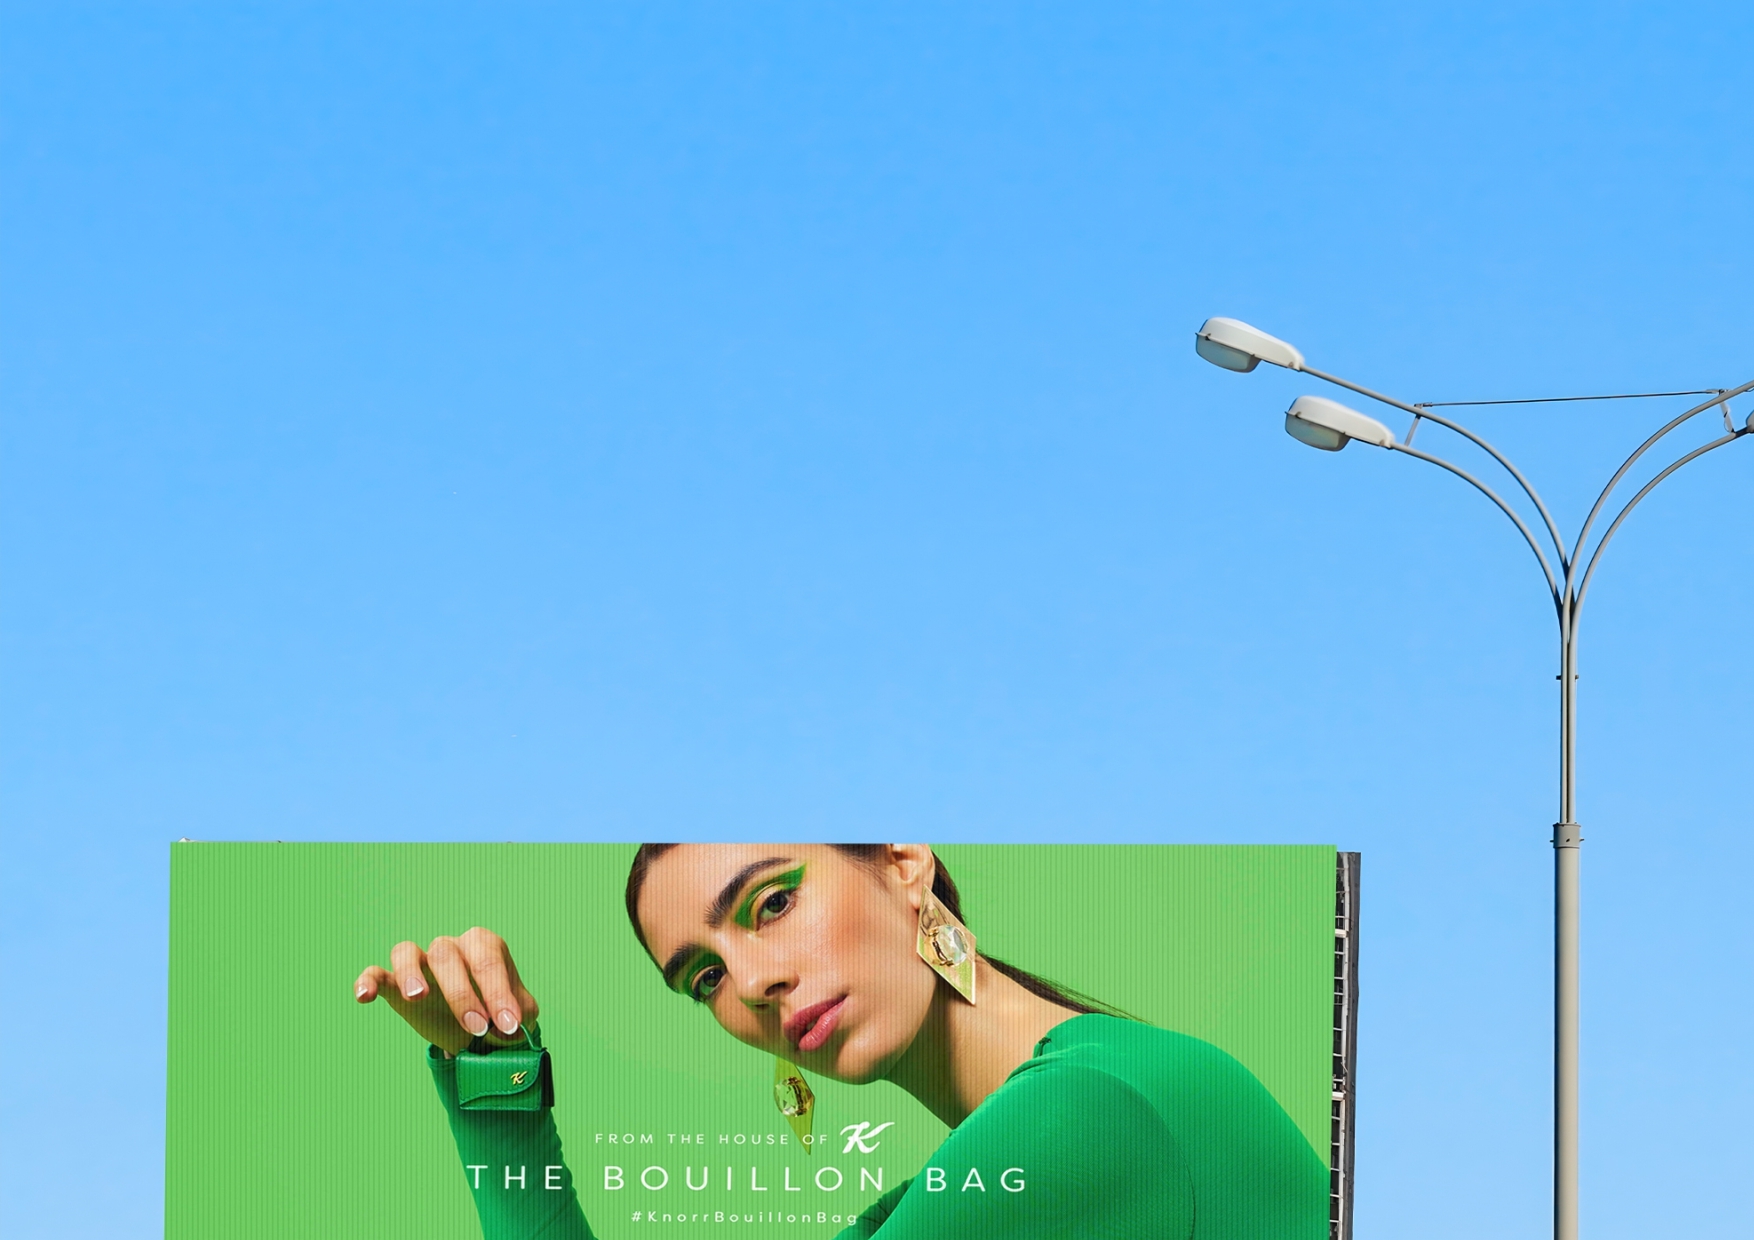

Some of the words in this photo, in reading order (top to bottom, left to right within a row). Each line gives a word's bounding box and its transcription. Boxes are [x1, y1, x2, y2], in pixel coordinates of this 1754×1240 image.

[595, 1133, 654, 1145] FROM
[667, 1133, 705, 1145] THE
[718, 1133, 788, 1145] HOUSE
[802, 1133, 828, 1145] OF
[466, 1164, 563, 1190] THE
[603, 1165, 883, 1191] BOUILLON
[926, 1167, 1025, 1192] BAG
[631, 1211, 857, 1225] #KnorrBouillonBag
